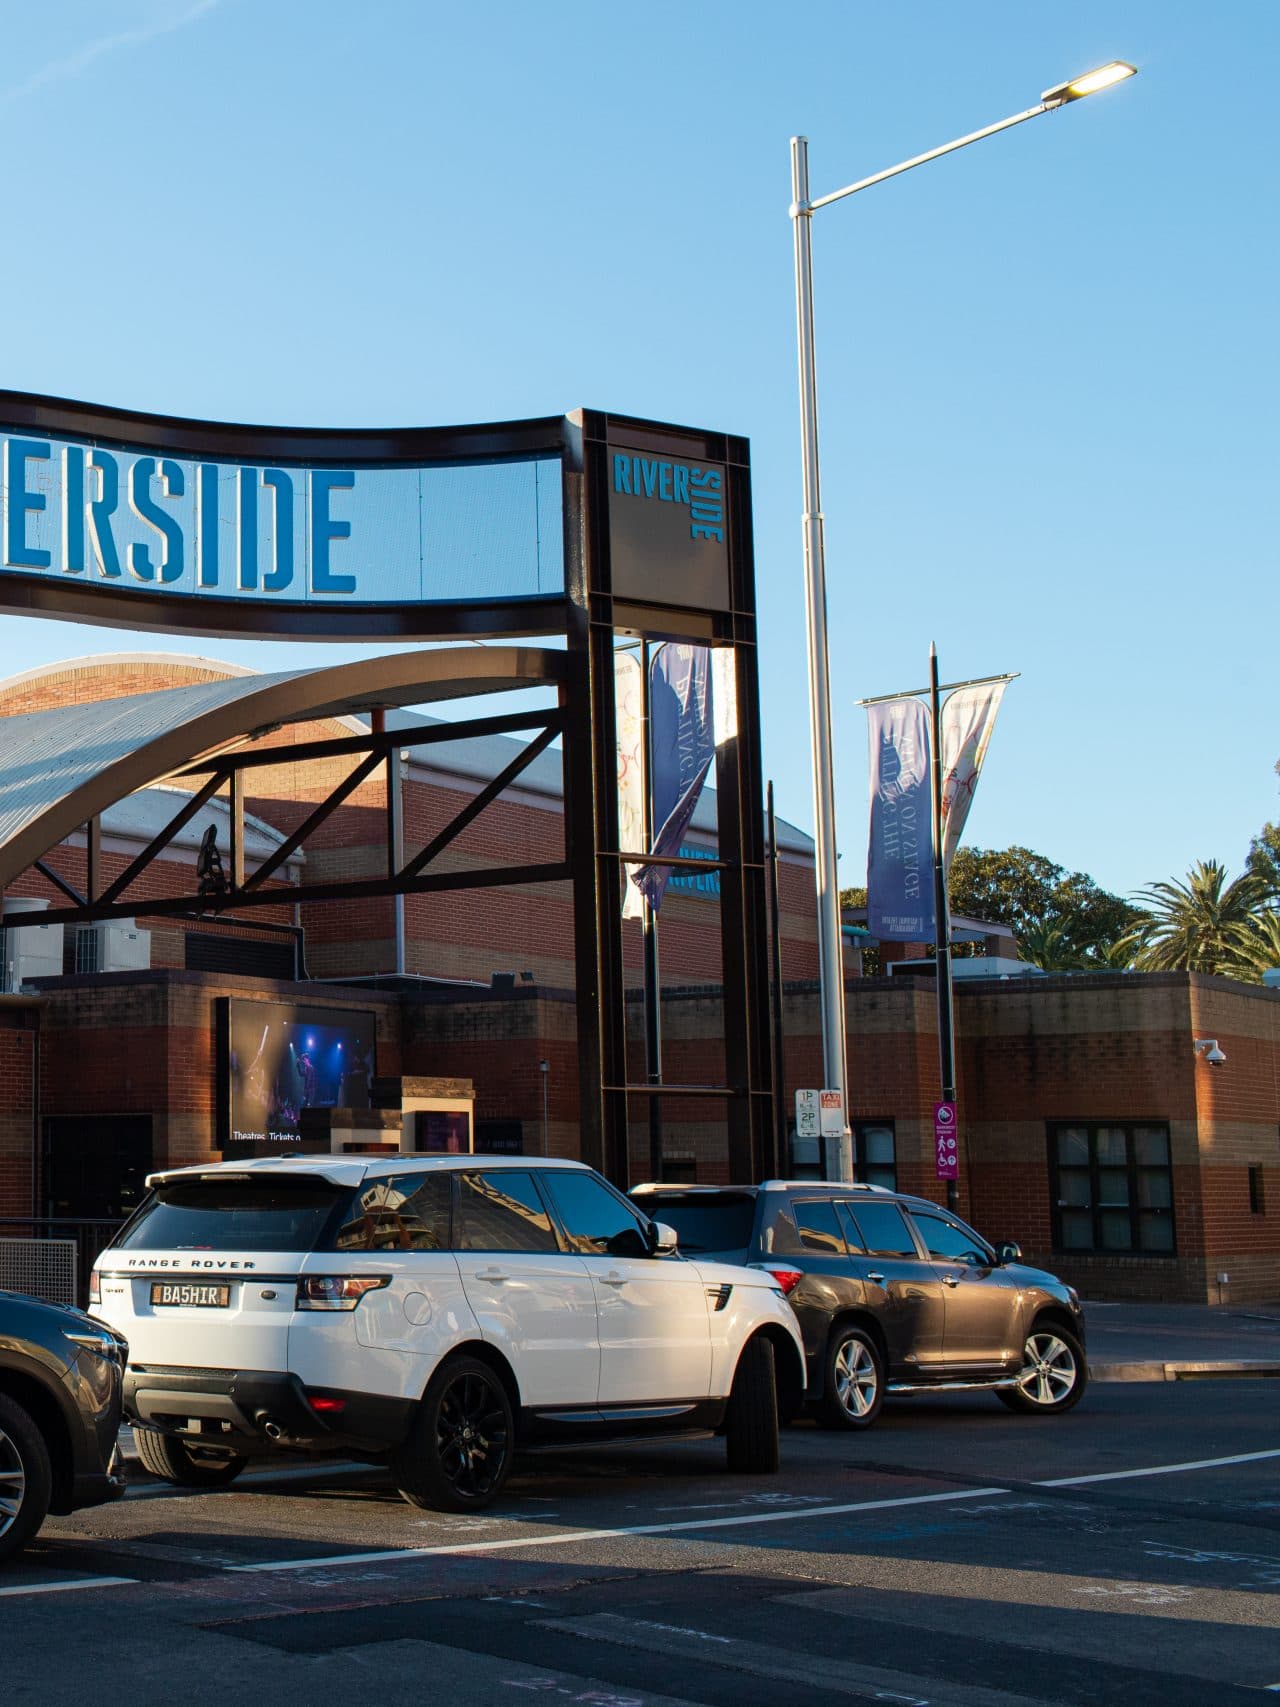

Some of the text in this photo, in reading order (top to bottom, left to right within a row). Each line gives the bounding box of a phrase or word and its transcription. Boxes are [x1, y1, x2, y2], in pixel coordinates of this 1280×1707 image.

[613, 454, 690, 504] RIVER
[690, 467, 724, 544] SIDE
[801, 1112, 815, 1121] 2P
[129, 1259, 255, 1269] RANGE ROVER
